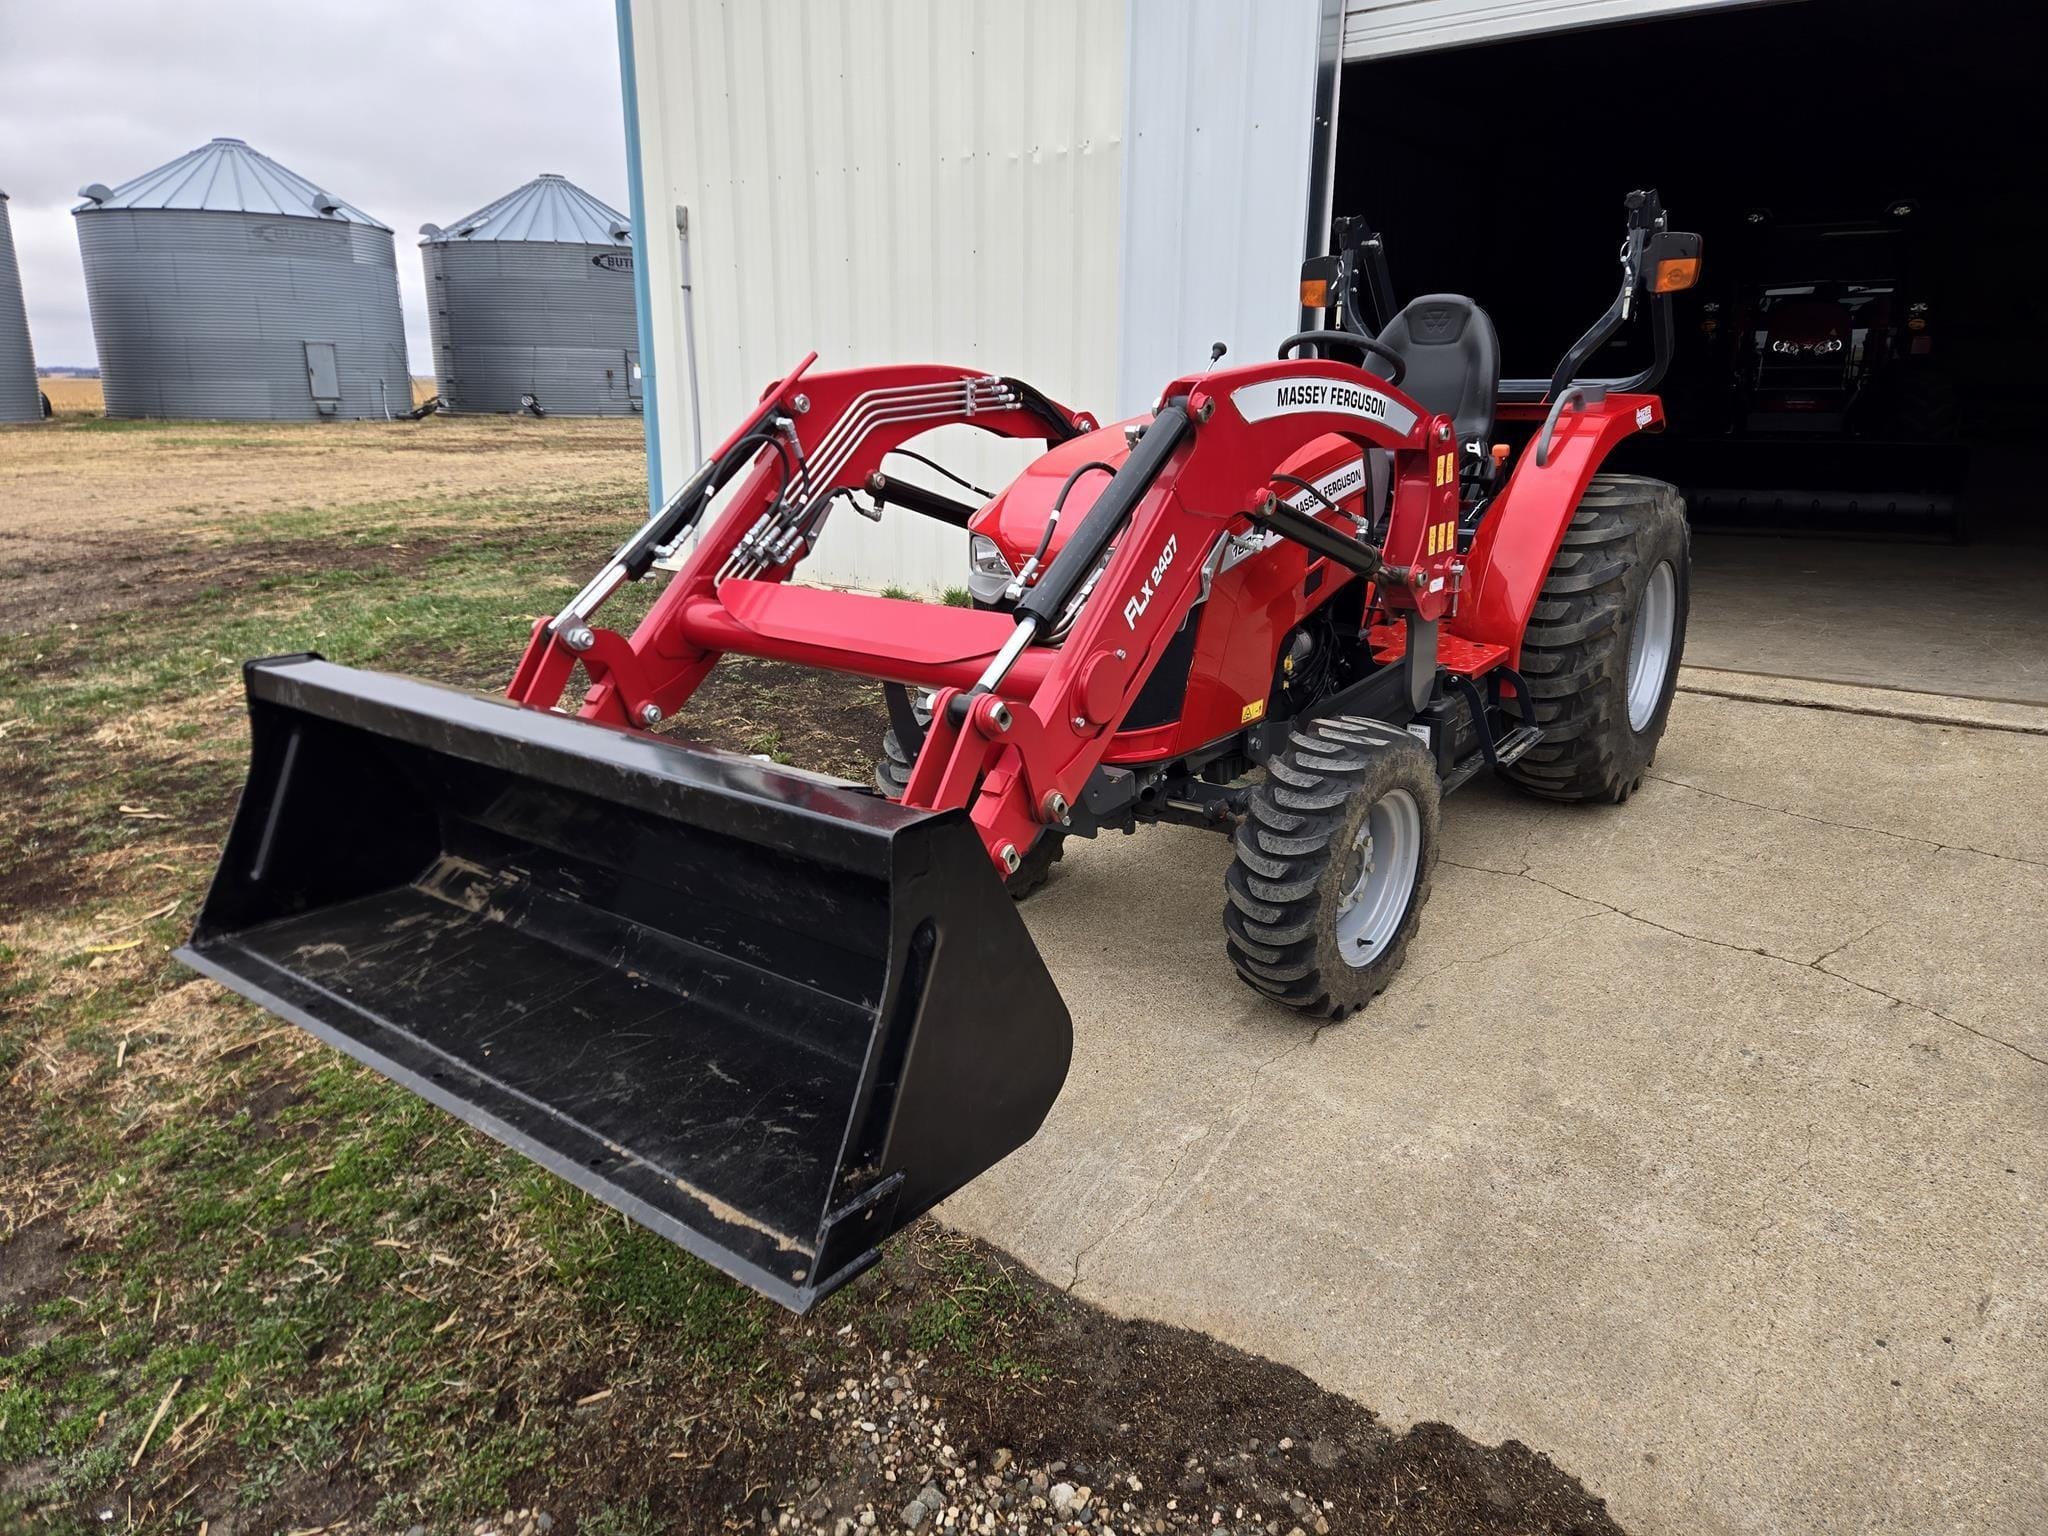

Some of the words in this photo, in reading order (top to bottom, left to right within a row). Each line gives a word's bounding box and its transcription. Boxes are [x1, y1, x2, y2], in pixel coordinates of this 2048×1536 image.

[1277, 385, 1327, 407] MASSEY
[1330, 386, 1386, 418] FERGUSON
[1295, 489, 1322, 513] ASSE
[1323, 468, 1362, 499] FERGUSON
[1123, 579, 1154, 631] FLX
[1151, 533, 1177, 587] 2407
